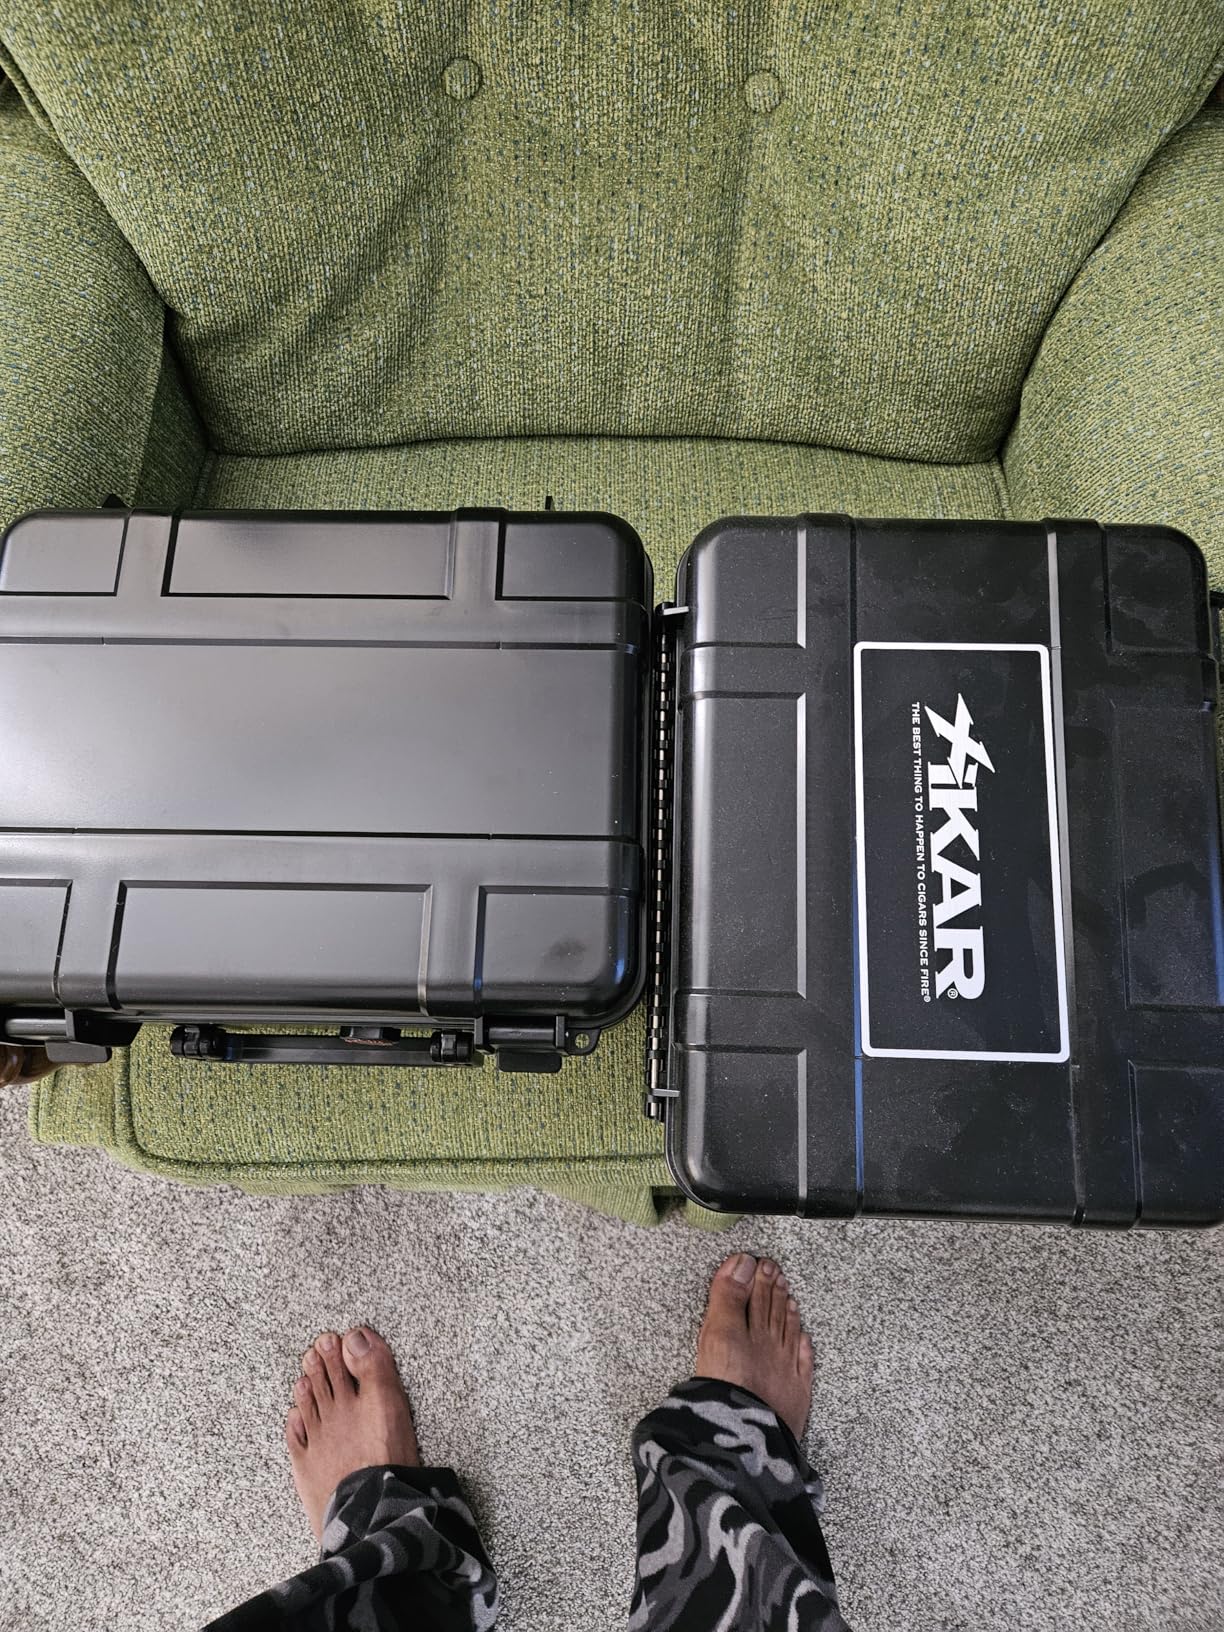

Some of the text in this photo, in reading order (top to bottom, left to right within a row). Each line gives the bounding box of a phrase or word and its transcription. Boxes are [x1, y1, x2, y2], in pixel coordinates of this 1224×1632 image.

[911, 701, 921, 725] THE
[912, 727, 922, 756] BEST
[913, 758, 923, 794] THING
[914, 796, 924, 812] TO
[915, 814, 925, 861] HAPPEN
[916, 863, 926, 880] TO
[917, 883, 928, 927] CIGARS
[919, 929, 929, 966] SINCE
